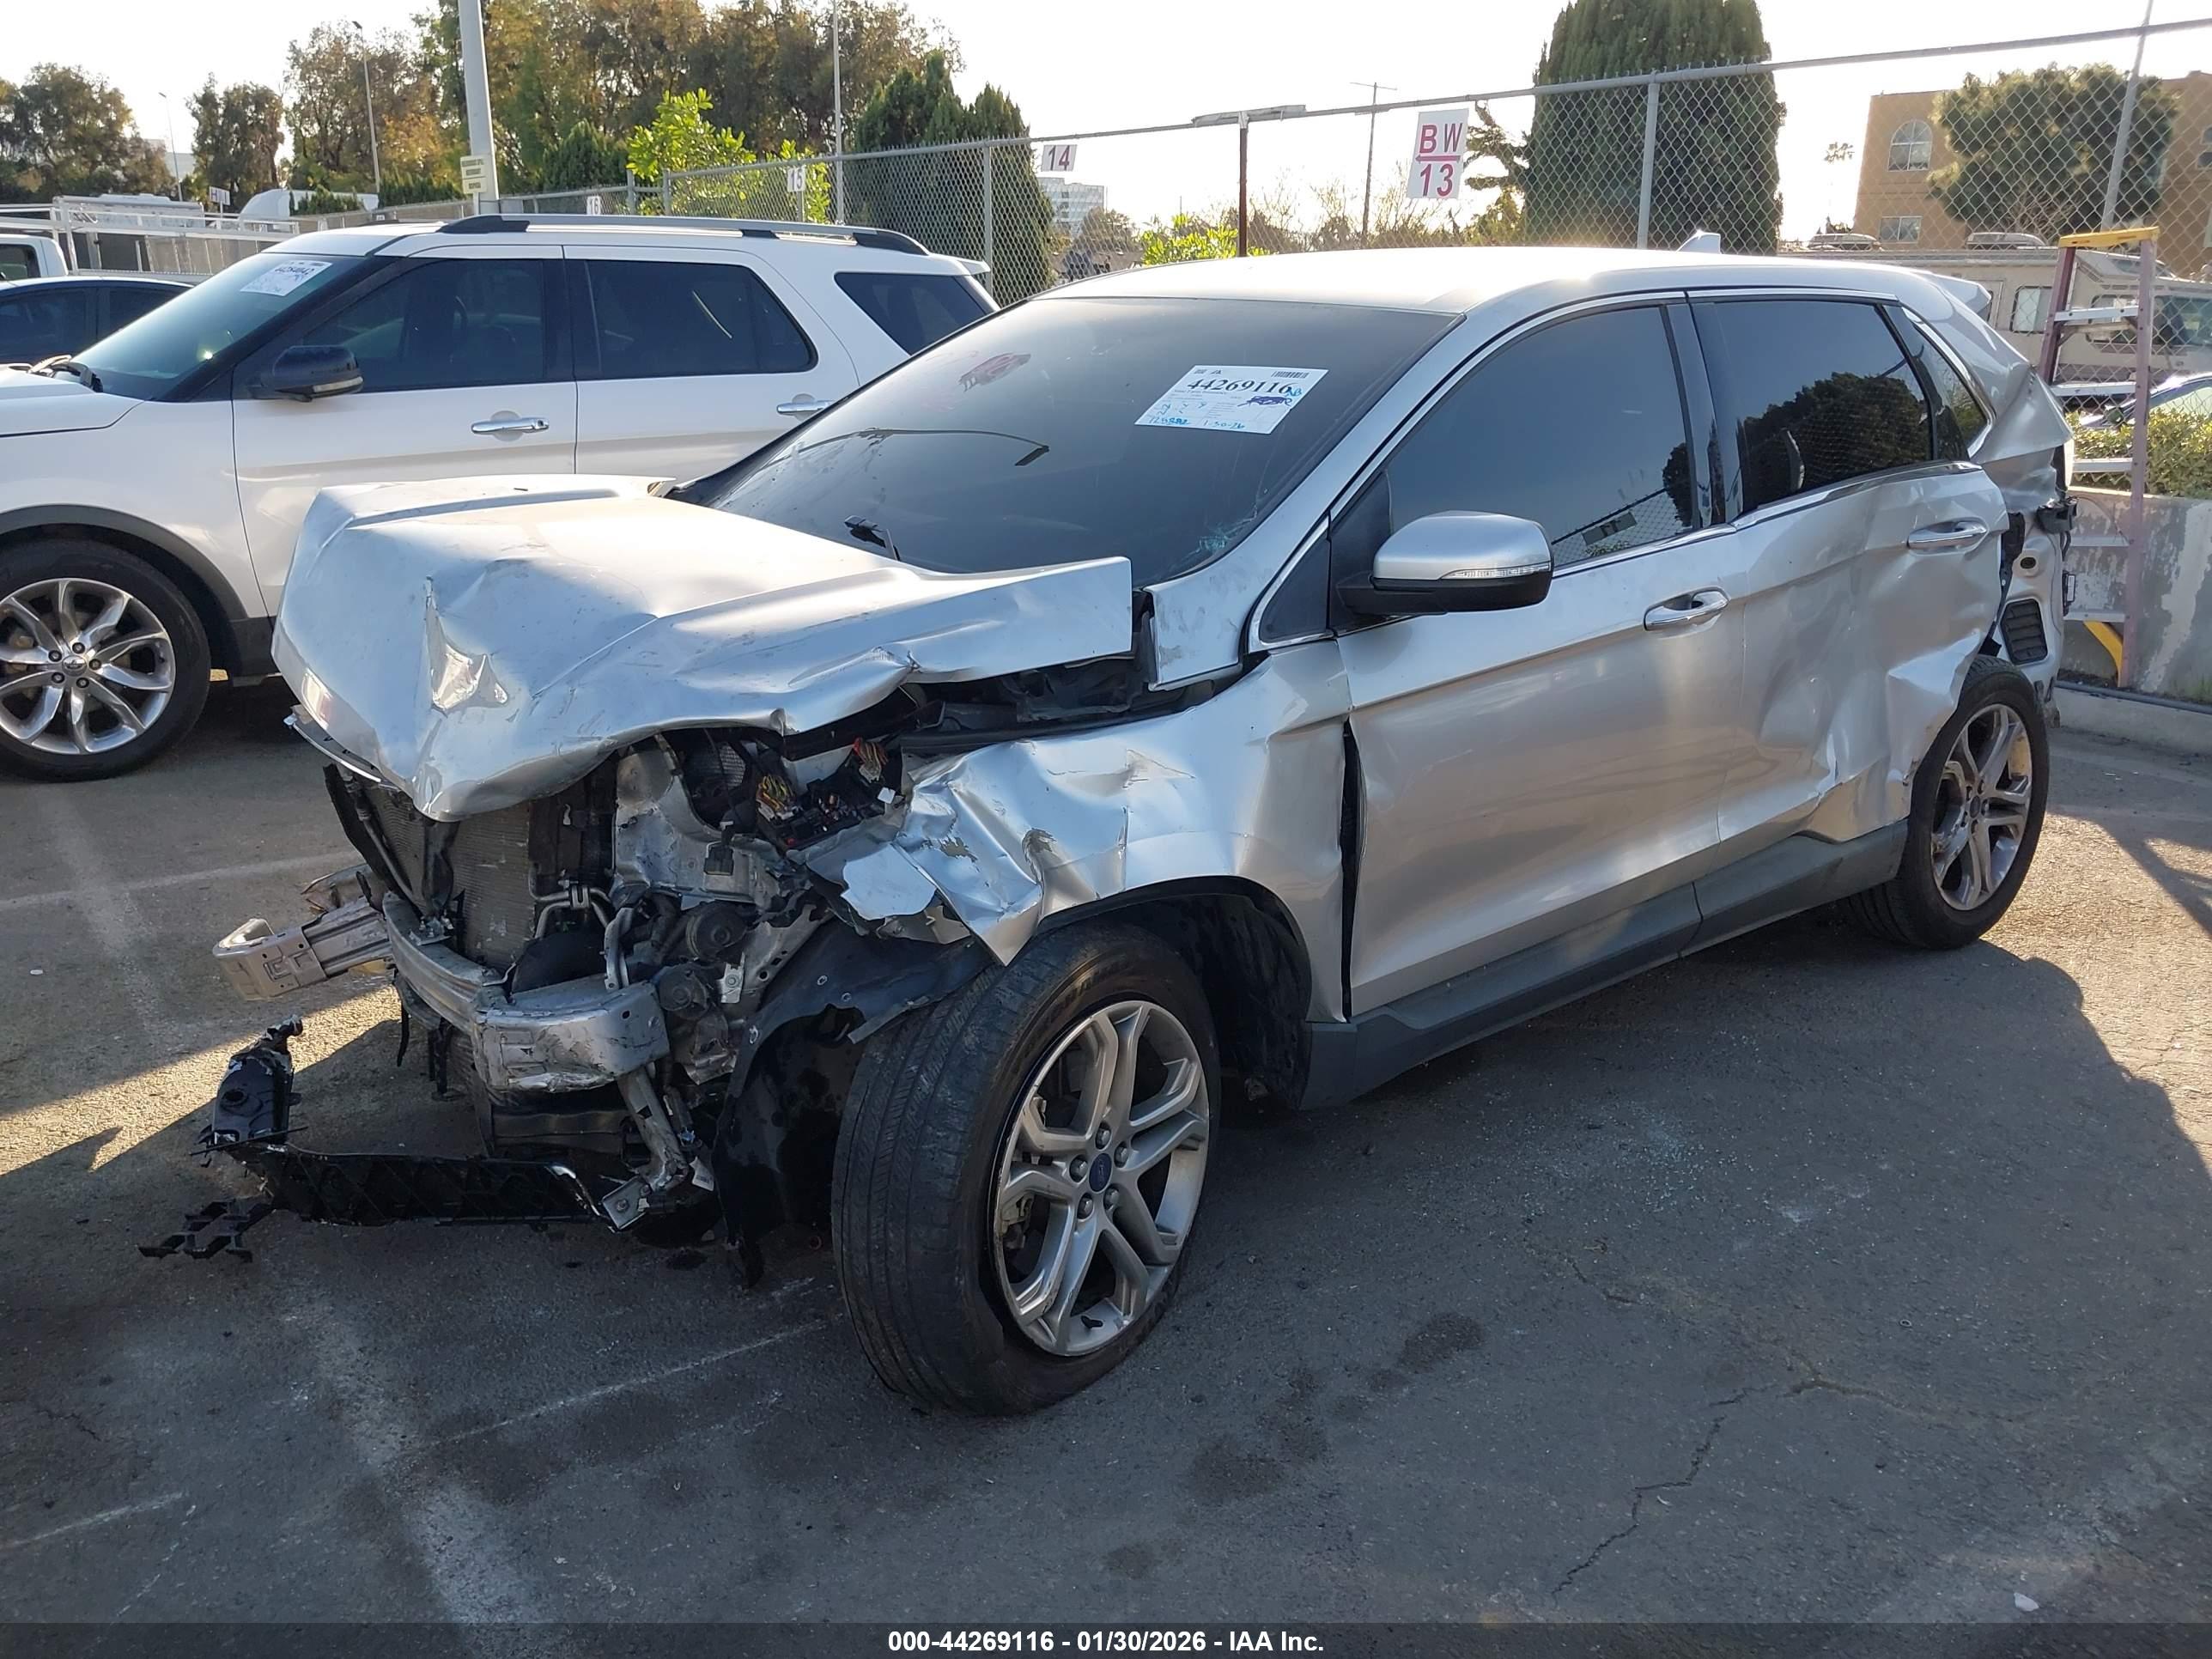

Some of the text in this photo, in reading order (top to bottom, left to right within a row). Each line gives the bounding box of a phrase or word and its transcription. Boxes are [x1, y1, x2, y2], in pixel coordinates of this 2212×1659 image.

[1419, 123, 1463, 154] BW
[1048, 145, 1070, 171] 14
[790, 169, 803, 190] 15
[1420, 163, 1454, 197] 13
[589, 198, 599, 215] 16
[1187, 378, 1298, 395] 44269116
